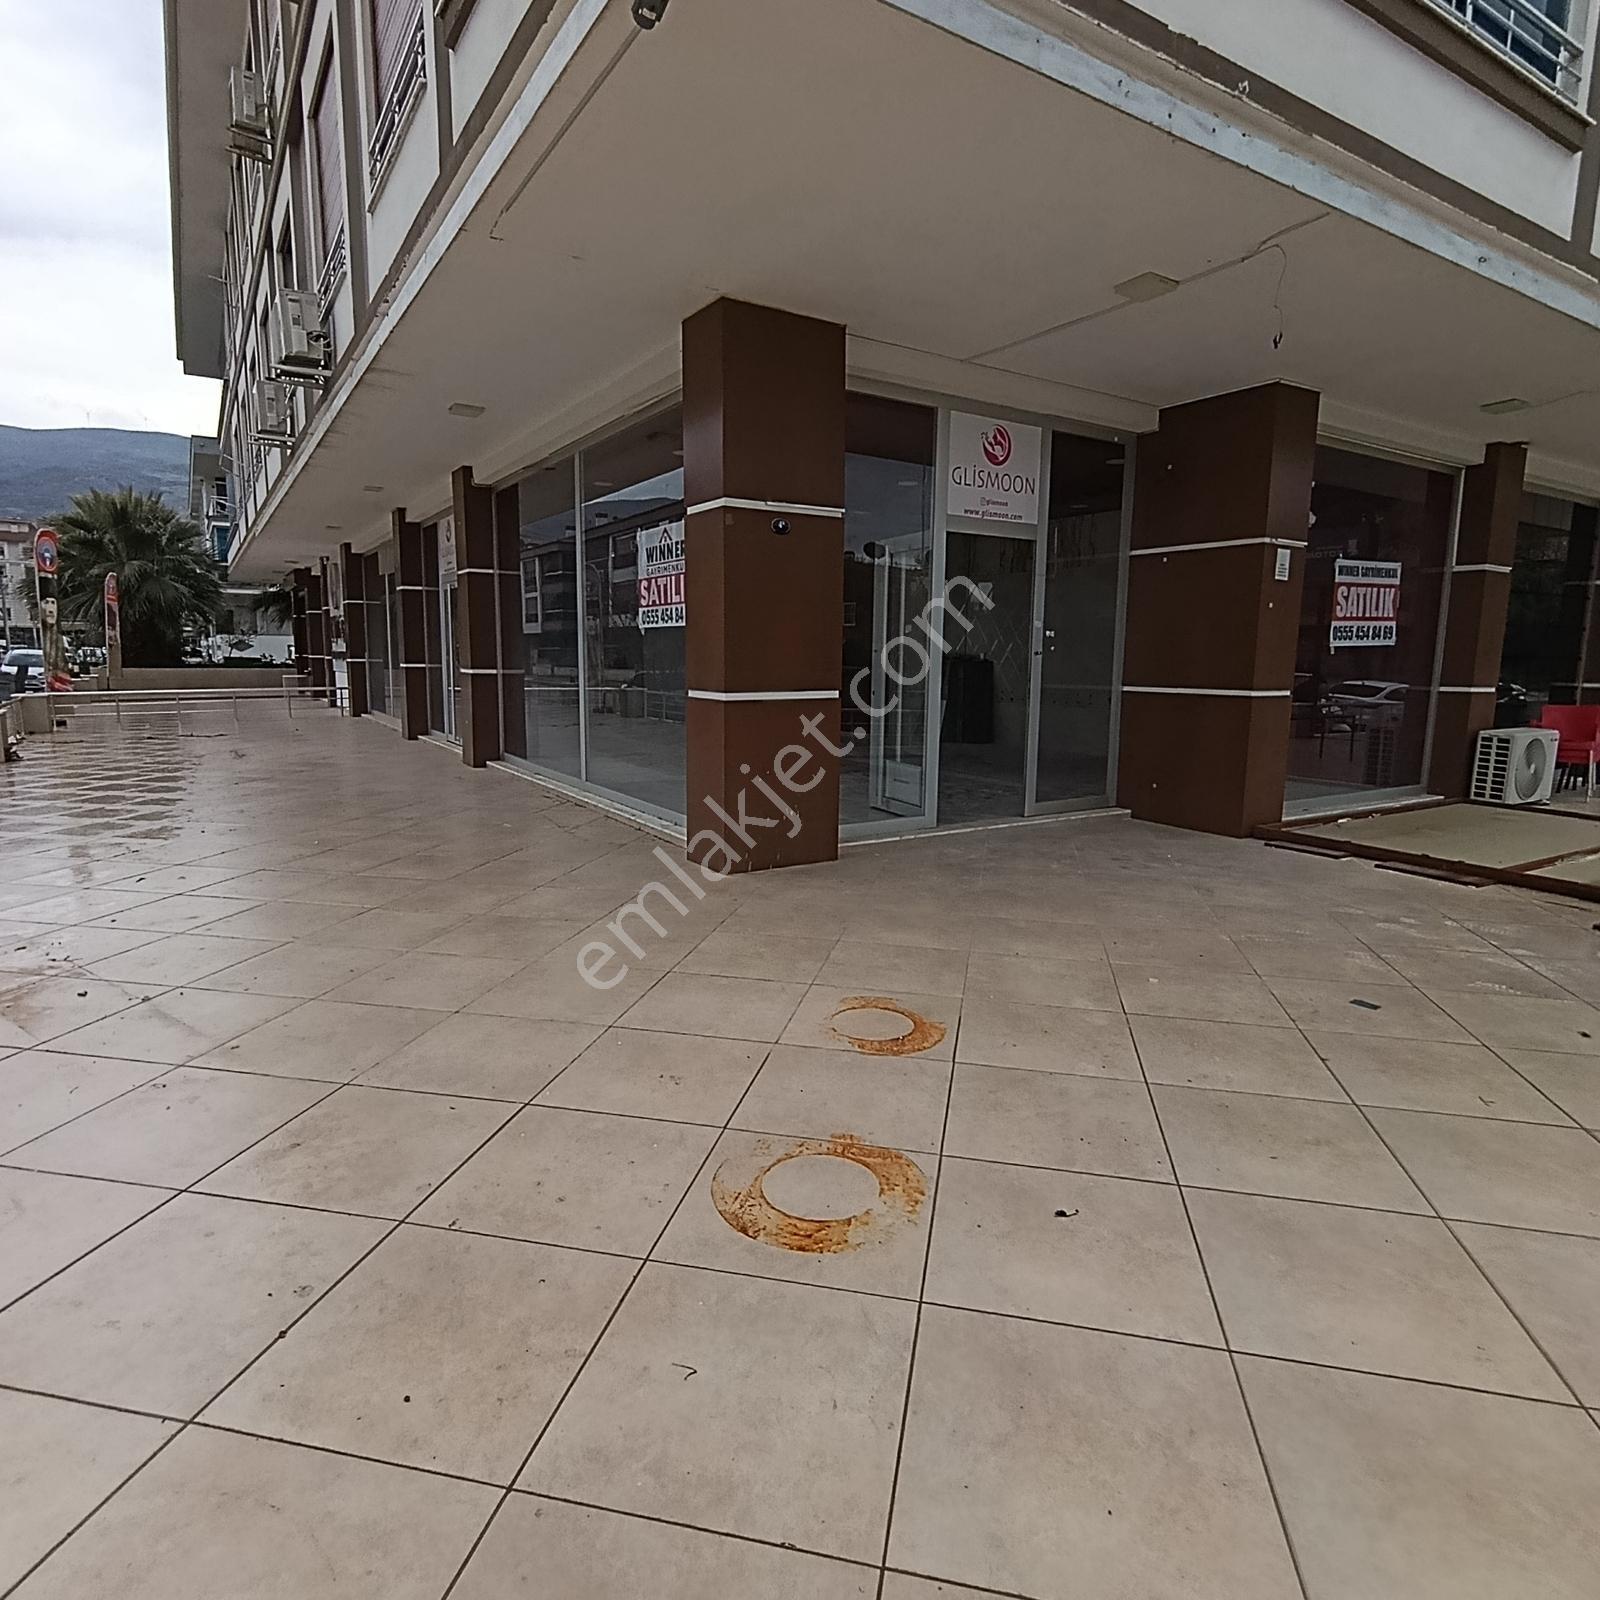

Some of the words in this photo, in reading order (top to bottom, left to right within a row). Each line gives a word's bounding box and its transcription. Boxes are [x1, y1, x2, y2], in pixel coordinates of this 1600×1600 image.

[964, 508, 1023, 521] www.glismoon.com
[1335, 585, 1396, 618] SATILIK
[641, 608, 659, 625] 0555
[660, 607, 674, 624] 454
[675, 606, 684, 624] 84
[1332, 625, 1354, 641] 0555
[1355, 625, 1371, 641] 454
[1371, 625, 1382, 640] 84
[1382, 625, 1394, 640] 69
